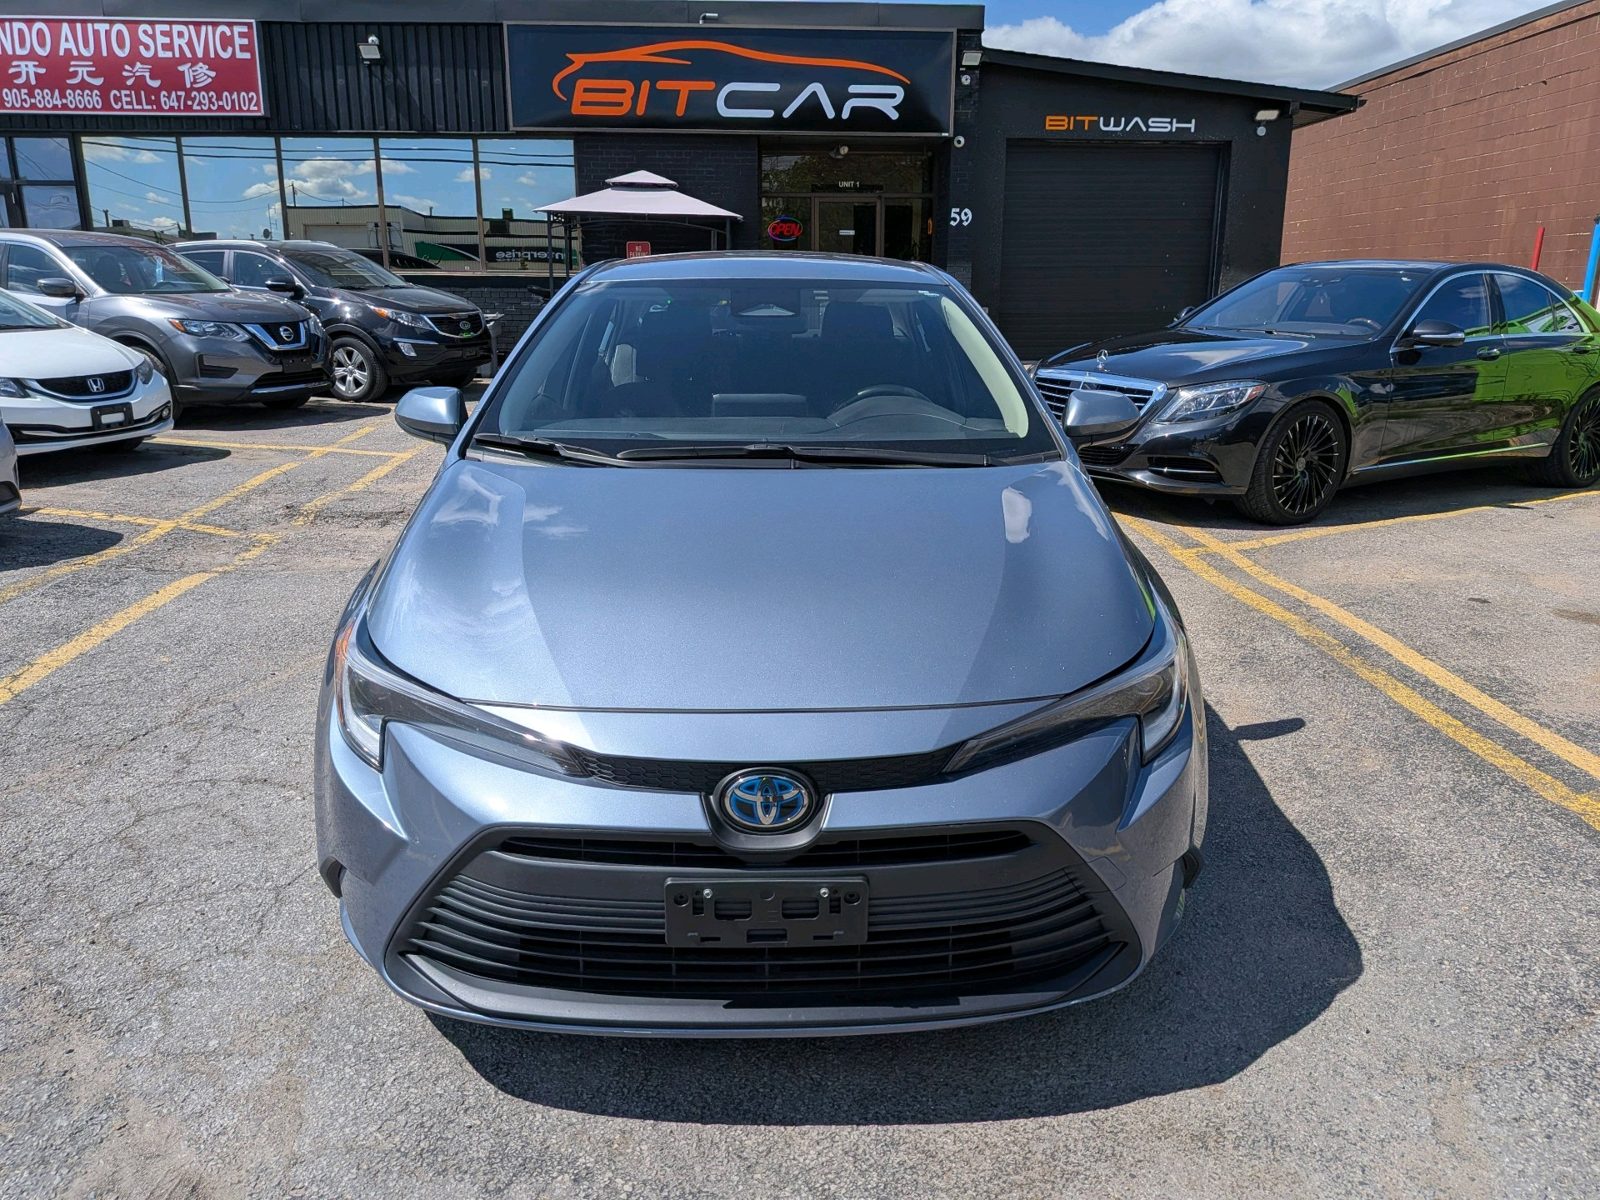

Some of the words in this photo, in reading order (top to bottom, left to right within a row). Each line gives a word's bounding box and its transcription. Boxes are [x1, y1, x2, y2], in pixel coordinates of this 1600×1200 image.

[58, 22, 131, 58] AUTO
[138, 24, 251, 60] SERVICE
[8, 60, 217, 89] 开元汽修
[2, 88, 103, 109] 905-884-8666
[109, 89, 157, 110] CELL:
[160, 90, 259, 111] 647-293-0102
[571, 78, 905, 120] BITCAR
[1045, 115, 1196, 133] BITWASH
[950, 207, 973, 226] 59
[771, 222, 801, 236] OPEN
